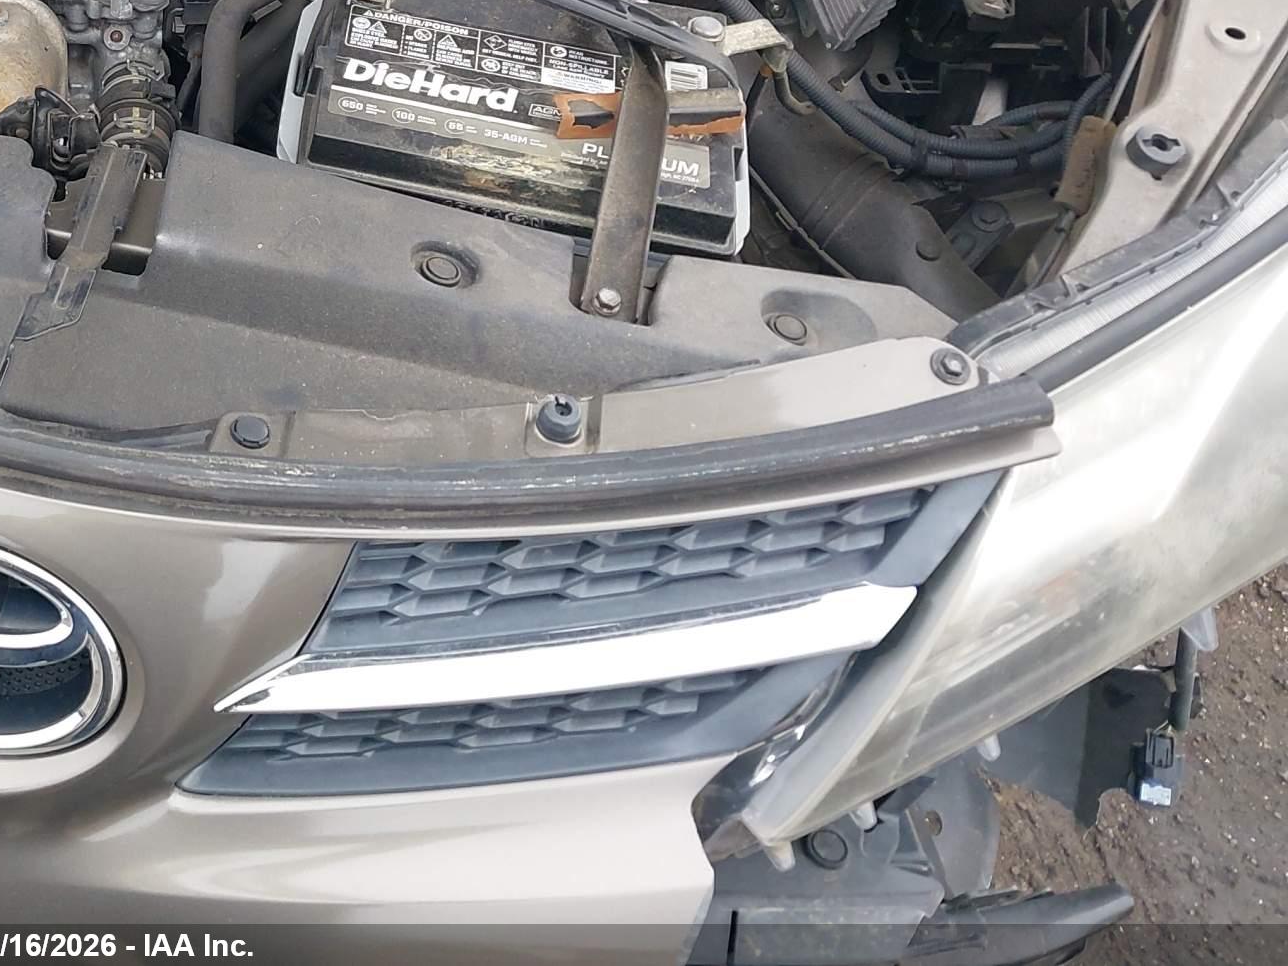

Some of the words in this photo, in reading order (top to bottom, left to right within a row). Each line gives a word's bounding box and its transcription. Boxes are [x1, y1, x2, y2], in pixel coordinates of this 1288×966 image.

[374, 10, 469, 35] DANGER/POISON
[341, 99, 364, 111] 650
[395, 110, 416, 122] 100
